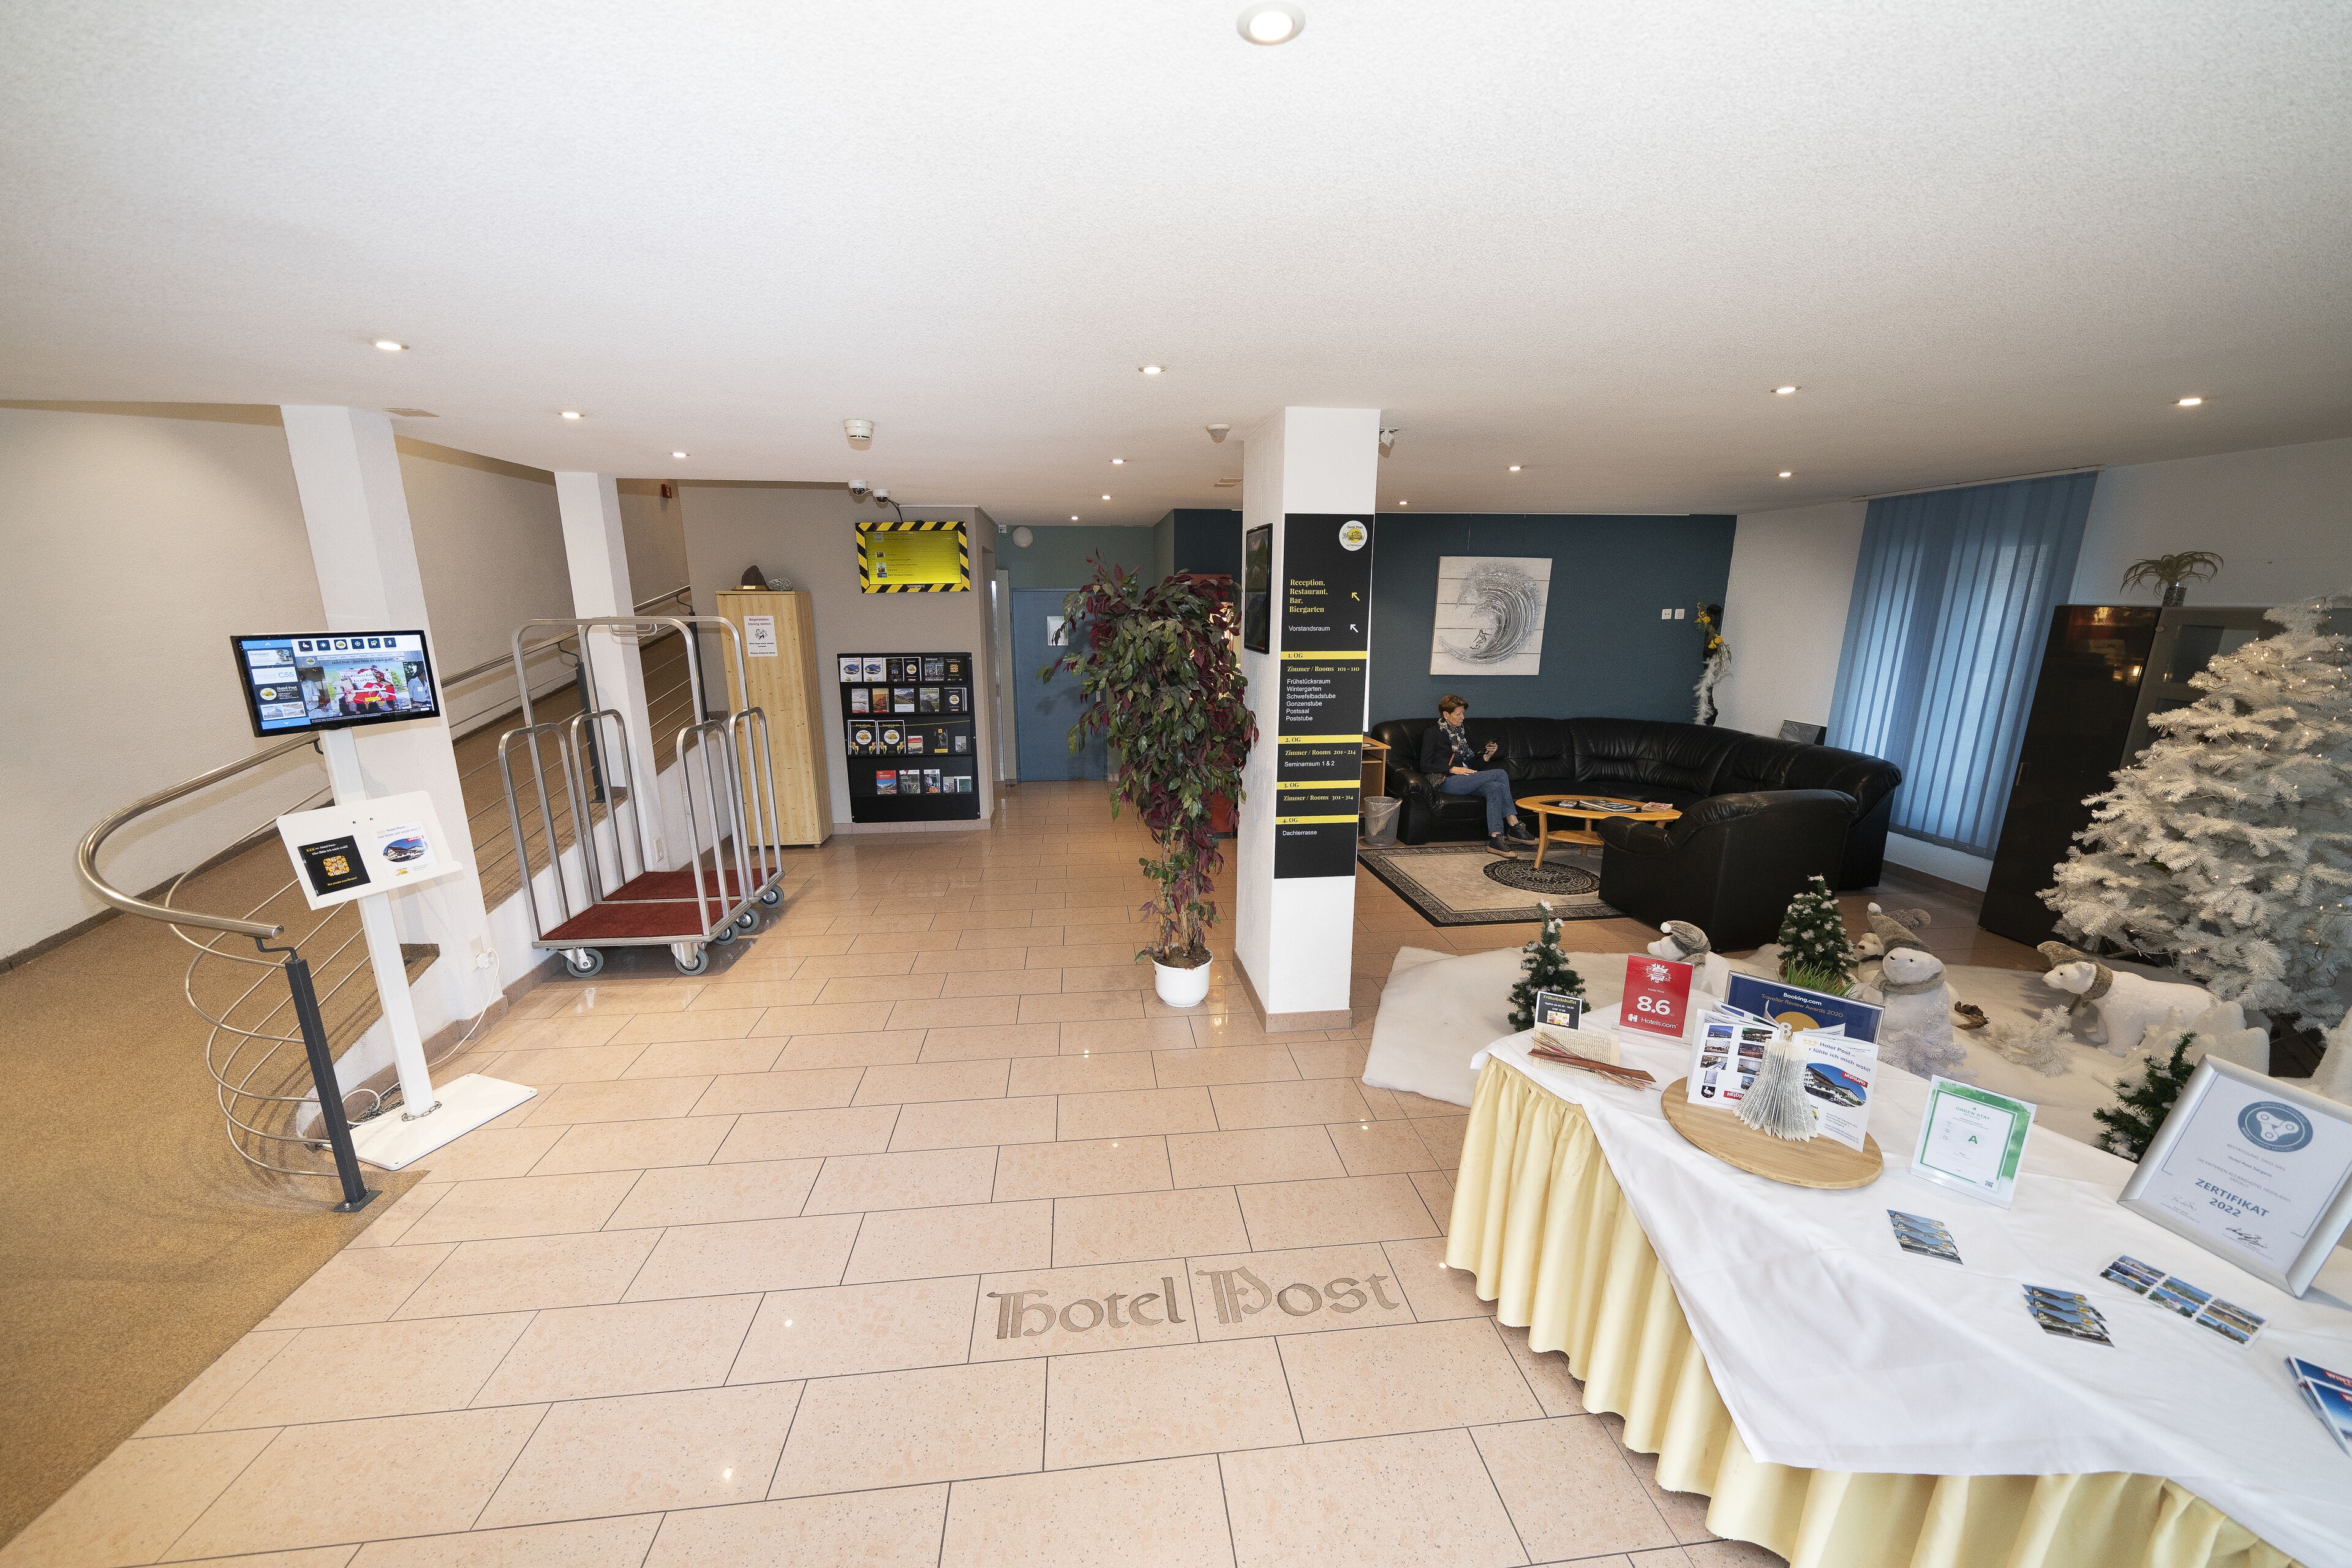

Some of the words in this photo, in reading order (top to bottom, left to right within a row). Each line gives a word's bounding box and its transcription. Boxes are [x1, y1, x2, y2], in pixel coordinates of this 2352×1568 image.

[1544, 995, 1577, 1005] Frühstücksbuffet
[1637, 995, 1670, 1016] 8.6
[1762, 993, 1784, 1003] Traveller
[1785, 999, 1804, 1009] Review
[1805, 1004, 1826, 1014] Awards
[1827, 1009, 1844, 1018] 2020
[1783, 992, 1822, 1006] Booking.com
[1820, 1042, 1836, 1050] Hotel
[1837, 1047, 1850, 1055] Post
[1840, 1057, 1854, 1066] mich
[1855, 1063, 1871, 1073] wohl!
[1956, 1106, 1975, 1115] GREEN
[1968, 1135, 1978, 1145] A
[2228, 1155, 2241, 1165] Hotel
[2253, 1166, 2272, 1178] Sargans
[2195, 1178, 2270, 1217] ZERTIFIKAT
[2209, 1197, 2242, 1218] 2022
[987, 1277, 1186, 1339] Hotel
[1196, 1267, 1400, 1324] Post
